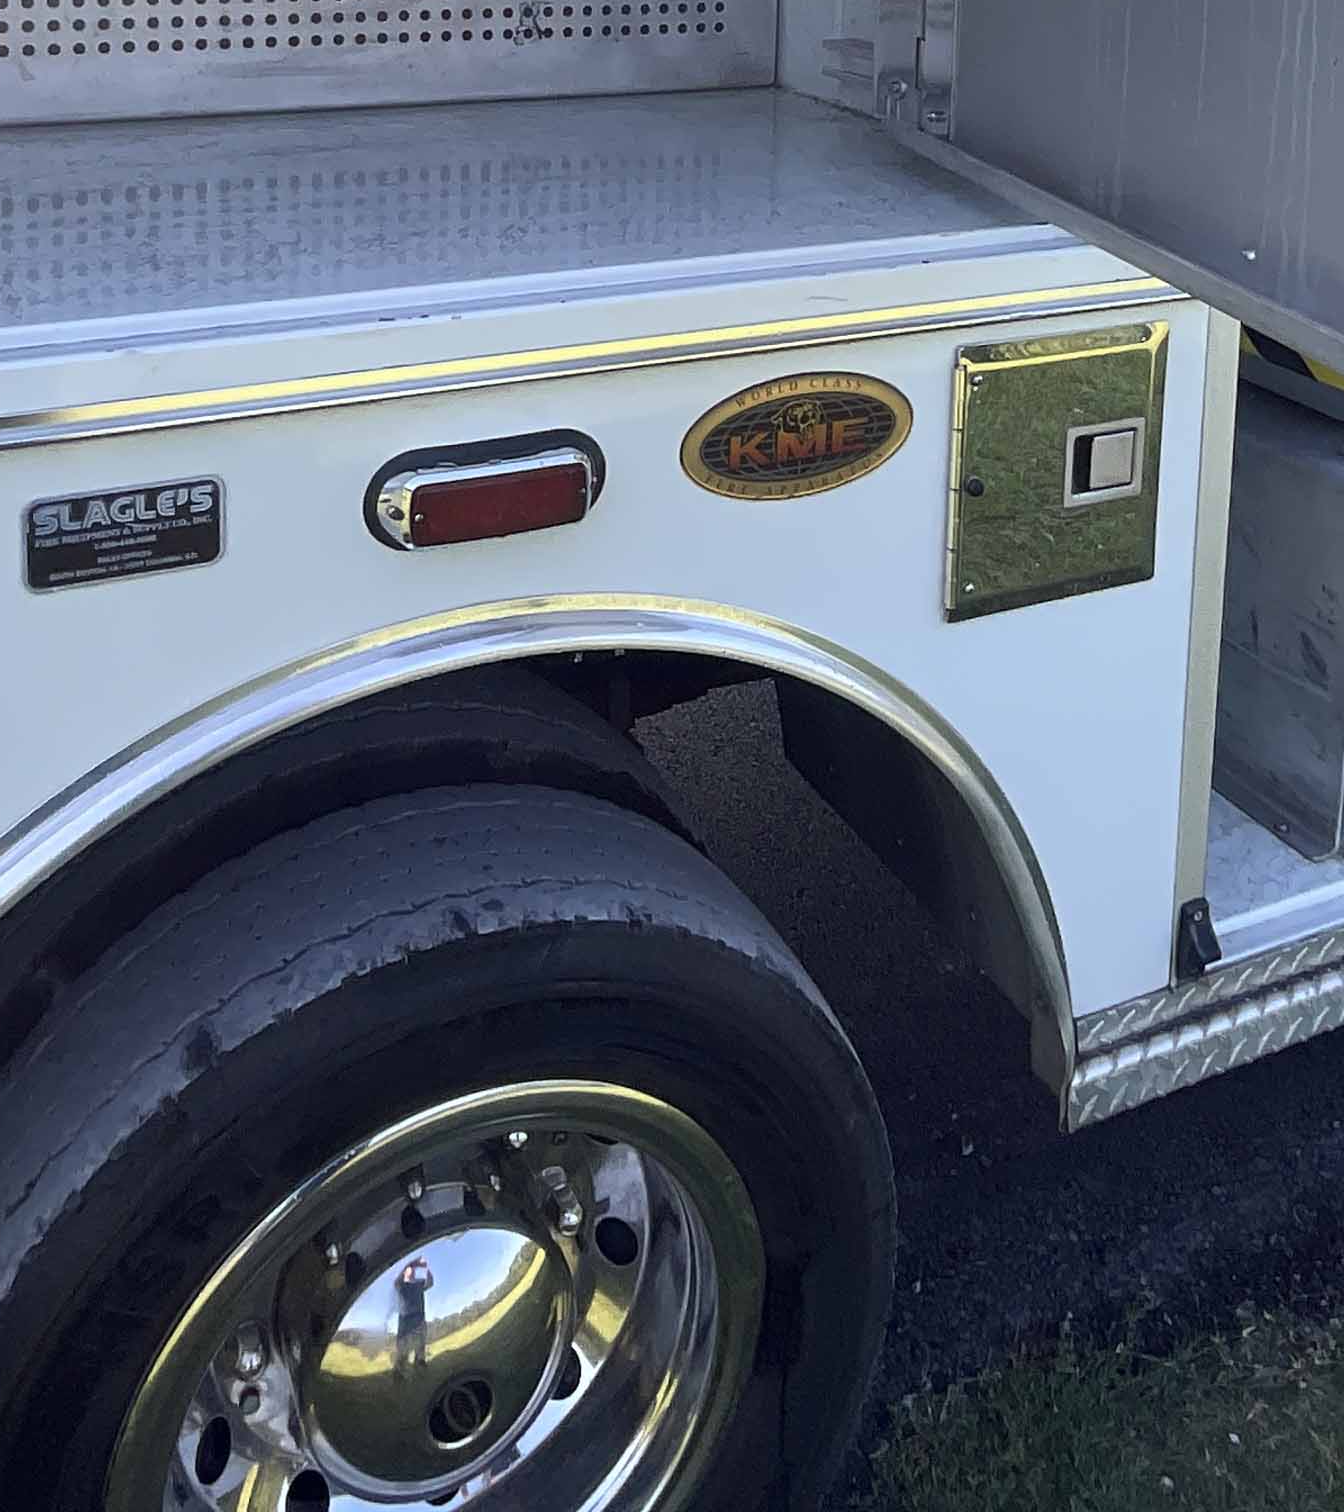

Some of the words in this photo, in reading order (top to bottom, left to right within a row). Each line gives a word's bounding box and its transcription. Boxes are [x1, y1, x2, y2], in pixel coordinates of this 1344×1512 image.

[735, 378, 799, 409] WORLD
[809, 376, 863, 389] CLASS
[726, 417, 869, 473] KME
[32, 485, 214, 537] SLAGLE'S
